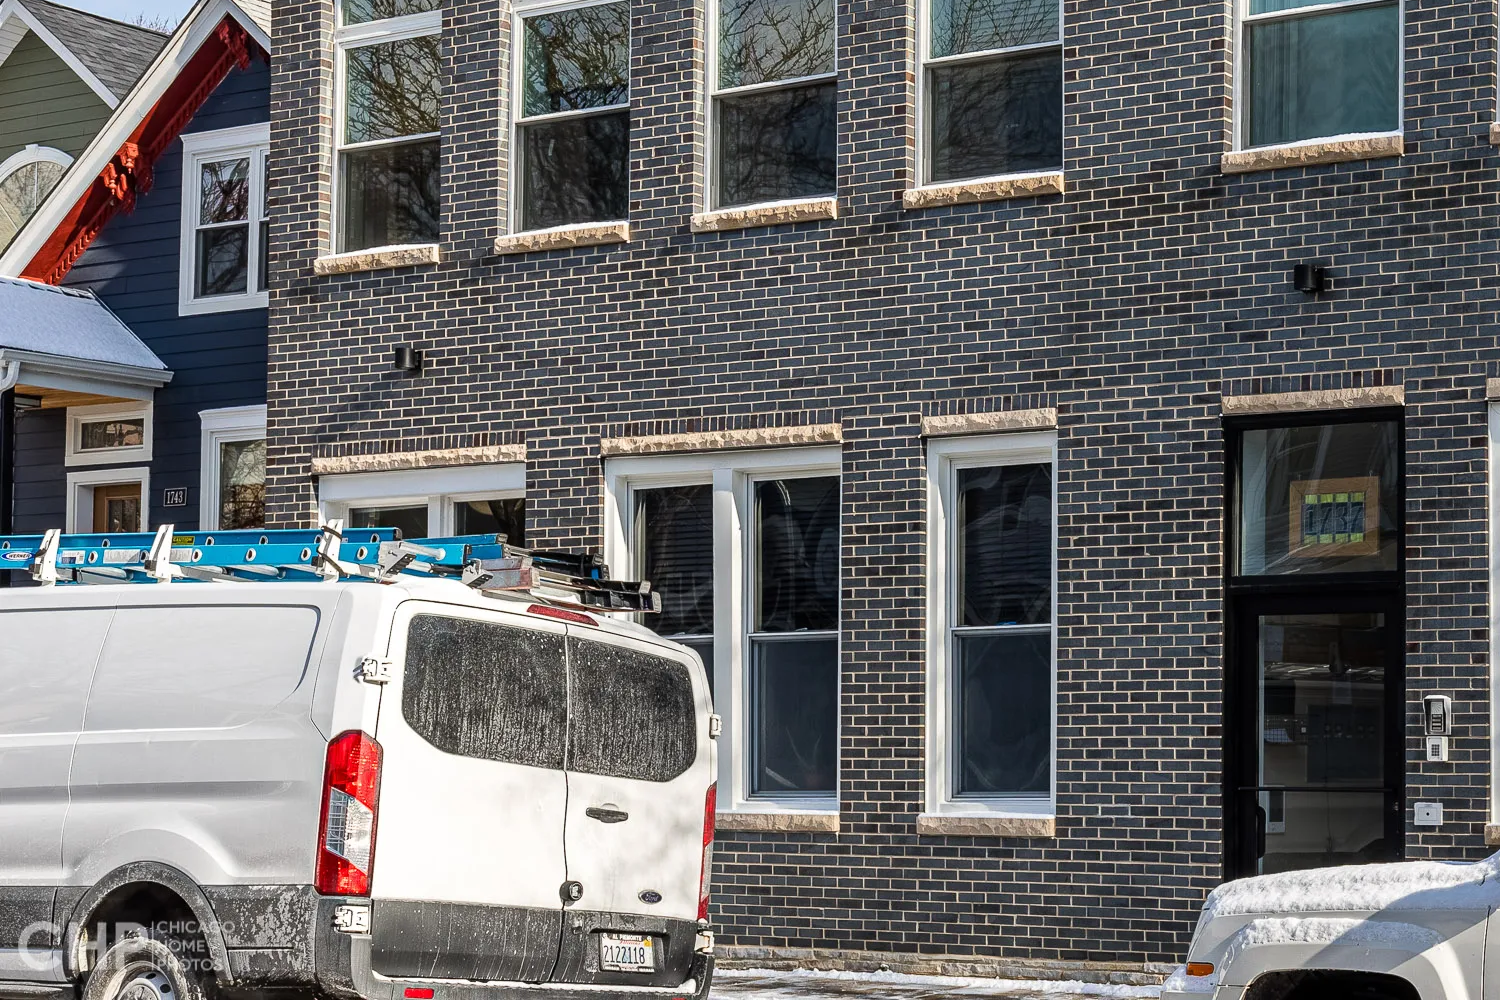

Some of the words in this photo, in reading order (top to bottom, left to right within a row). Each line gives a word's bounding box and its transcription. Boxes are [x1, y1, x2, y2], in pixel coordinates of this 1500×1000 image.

[166, 491, 183, 504] 1743
[1304, 505, 1363, 535] 1737
[644, 892, 659, 902] Ford
[603, 945, 646, 965] 2122118
